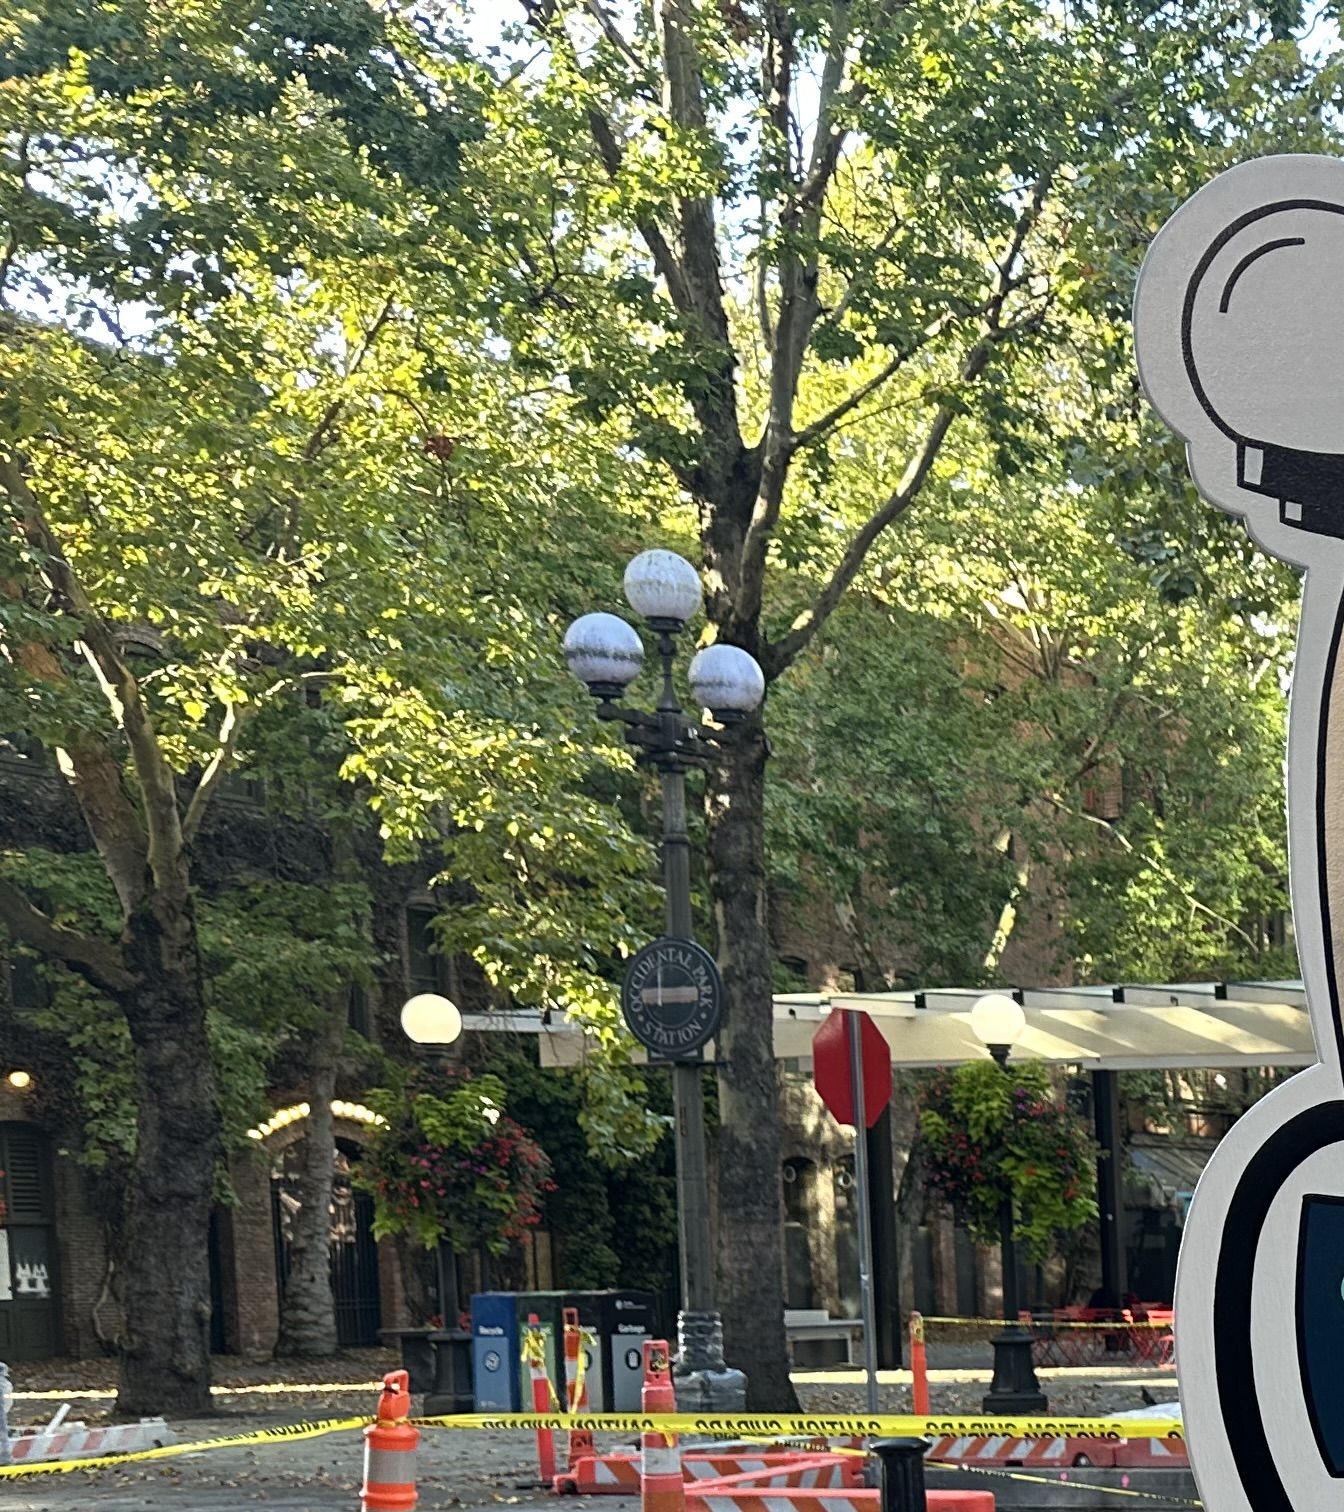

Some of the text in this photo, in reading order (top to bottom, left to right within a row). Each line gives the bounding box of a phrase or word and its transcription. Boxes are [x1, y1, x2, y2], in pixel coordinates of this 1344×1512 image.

[631, 948, 713, 1012] OCCIDENTAL PARK
[643, 1018, 703, 1046] STATION
